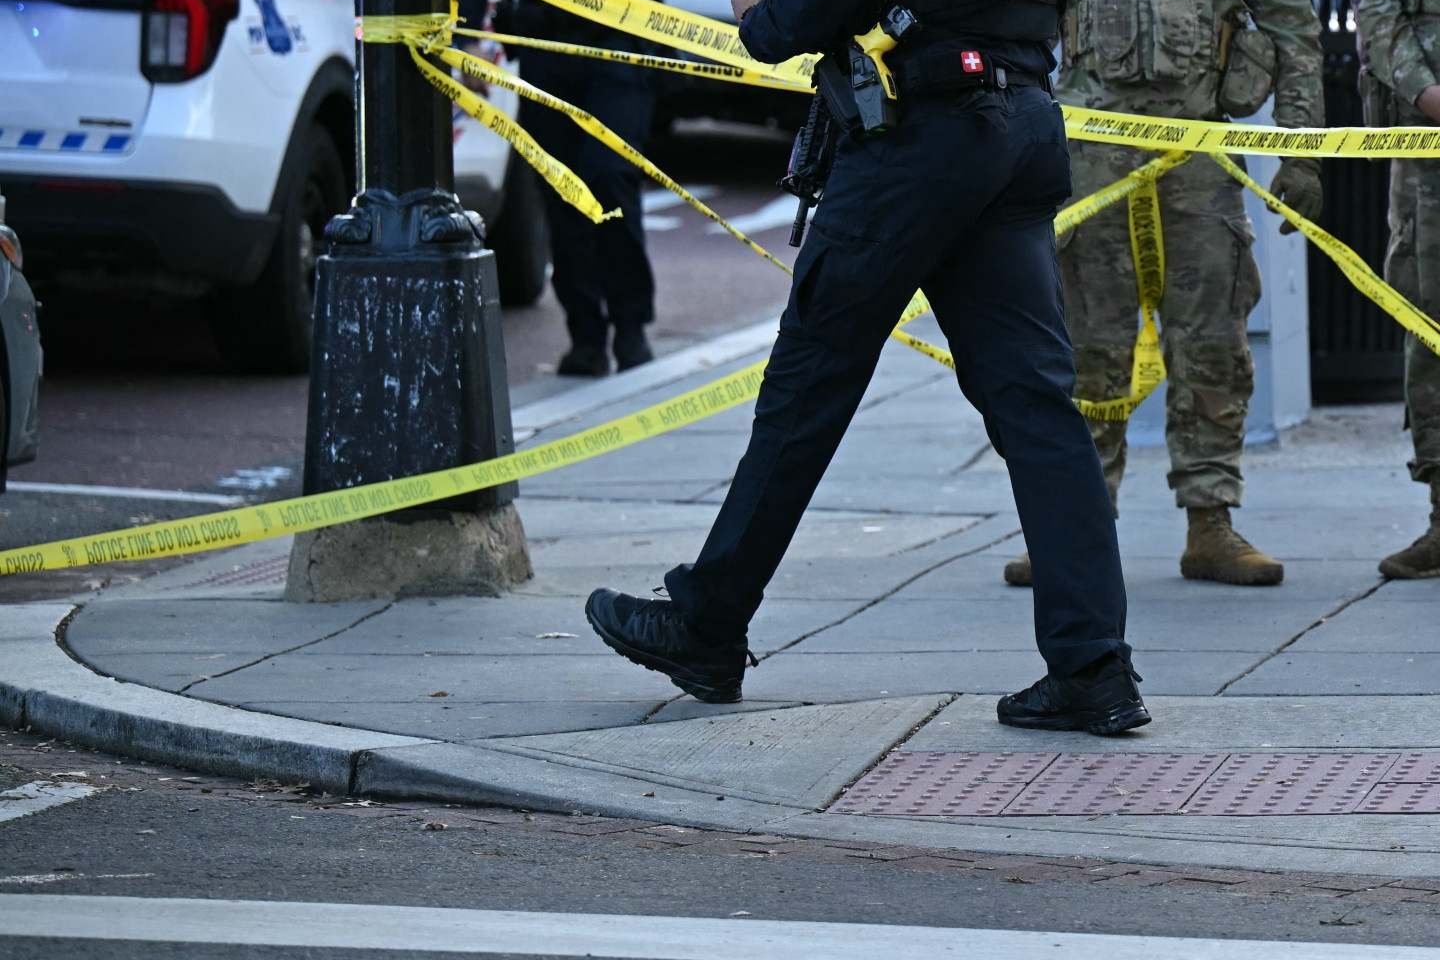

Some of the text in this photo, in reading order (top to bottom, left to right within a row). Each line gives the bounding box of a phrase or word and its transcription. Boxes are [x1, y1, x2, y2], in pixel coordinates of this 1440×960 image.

[645, 11, 680, 37] POLICE
[678, 21, 701, 41] LINE
[699, 26, 713, 46] DO
[711, 30, 732, 52] NOT
[1081, 117, 1188, 143] POLICE LINE DO NOT CROSS
[1219, 130, 1328, 150] POLICE LINE DO NOT CROSS
[1358, 134, 1392, 150] POLICE
[1386, 134, 1409, 150] LINE
[1405, 134, 1420, 150] DO
[1416, 133, 1437, 150] NOT
